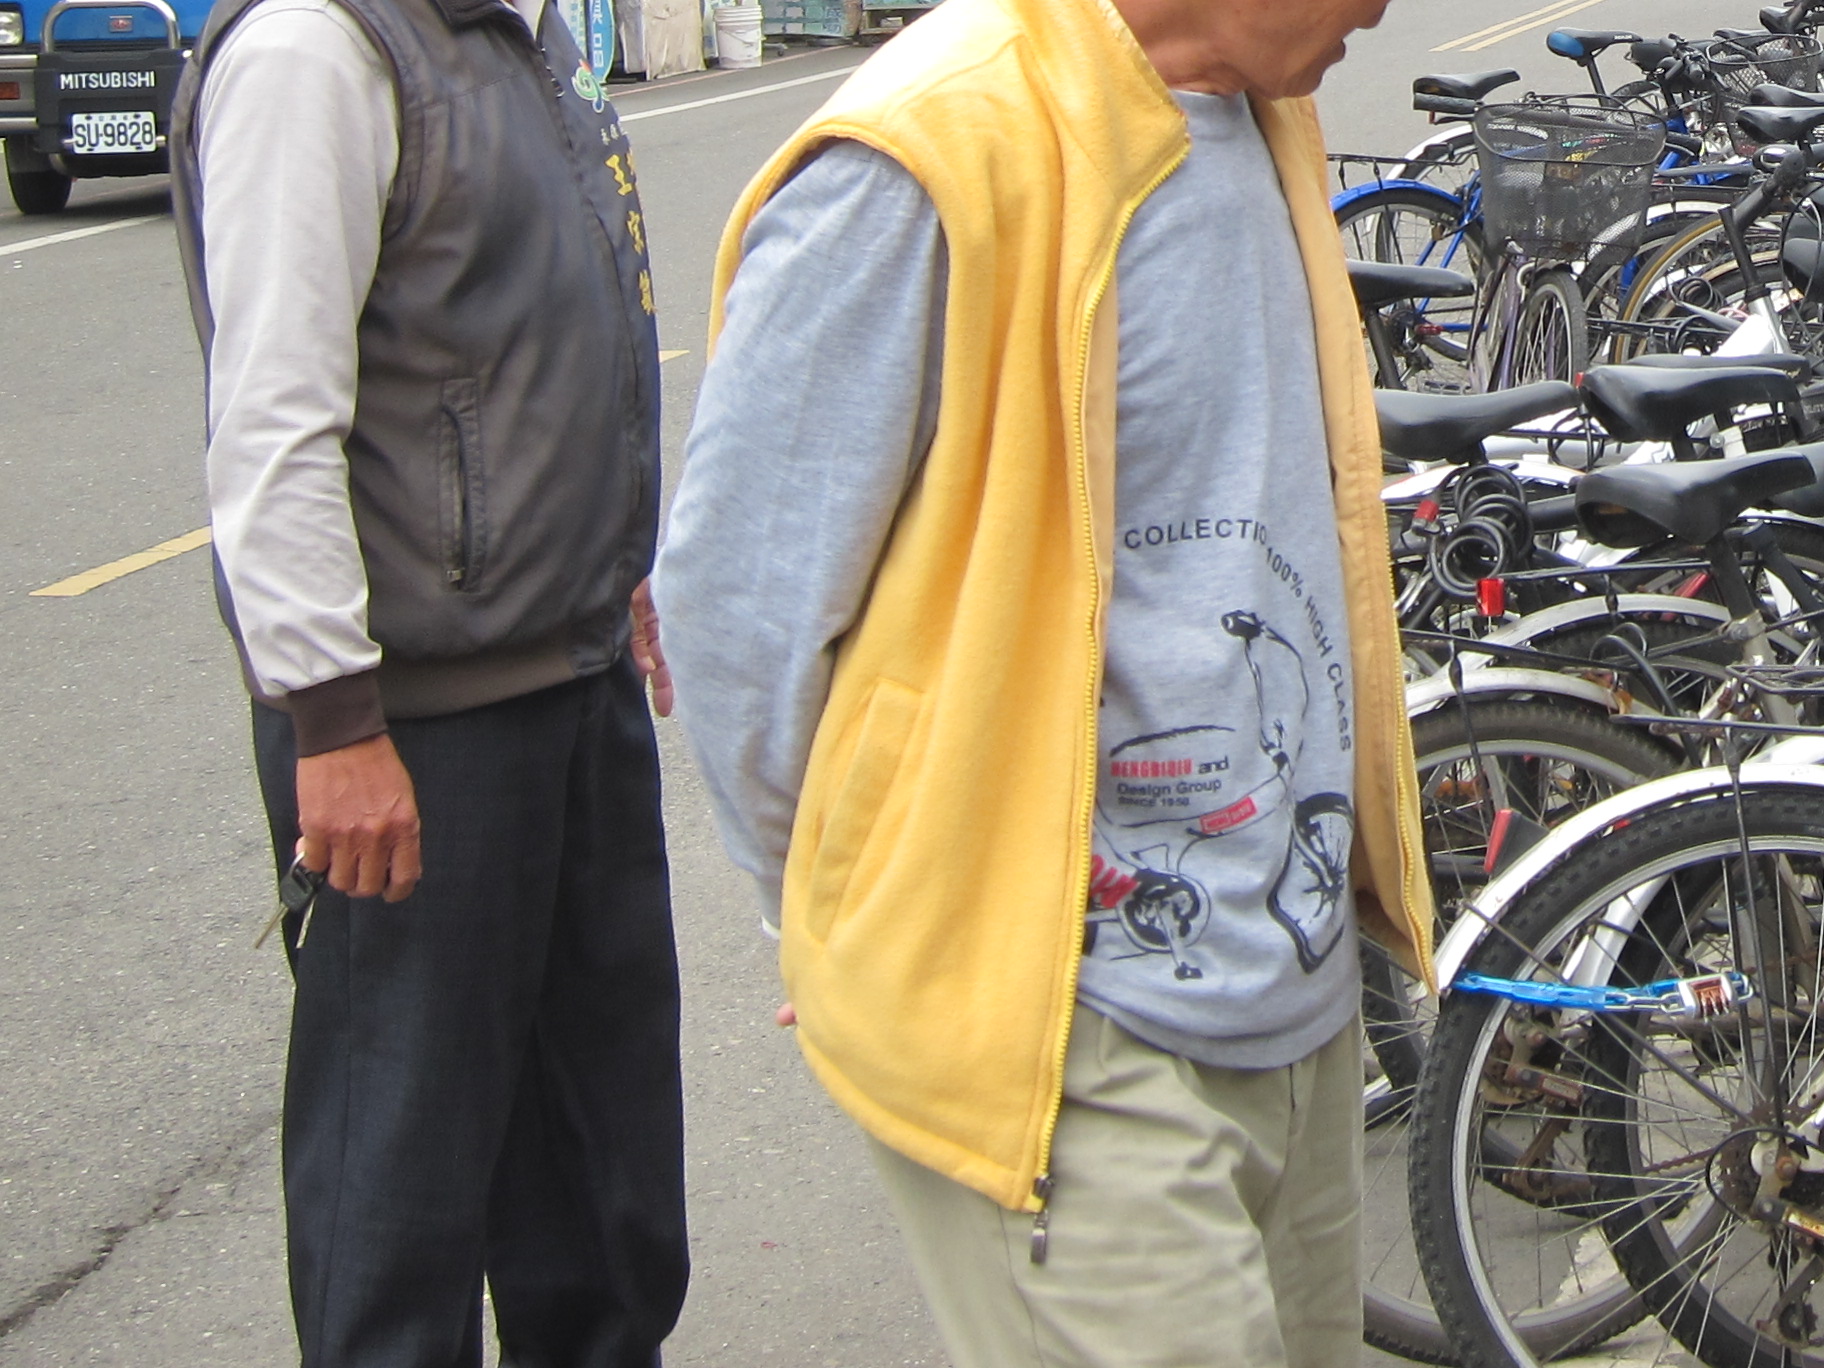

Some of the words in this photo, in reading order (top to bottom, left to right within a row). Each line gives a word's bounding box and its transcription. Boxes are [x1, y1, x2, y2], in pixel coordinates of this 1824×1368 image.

[60, 71, 155, 90] MITSUBISHI
[74, 121, 153, 148] SU-9828
[1305, 595, 1334, 658] HIGH
[1198, 755, 1229, 774] and
[1117, 782, 1171, 798] Design
[1176, 778, 1222, 795] Group
[1118, 796, 1156, 807] SINCE
